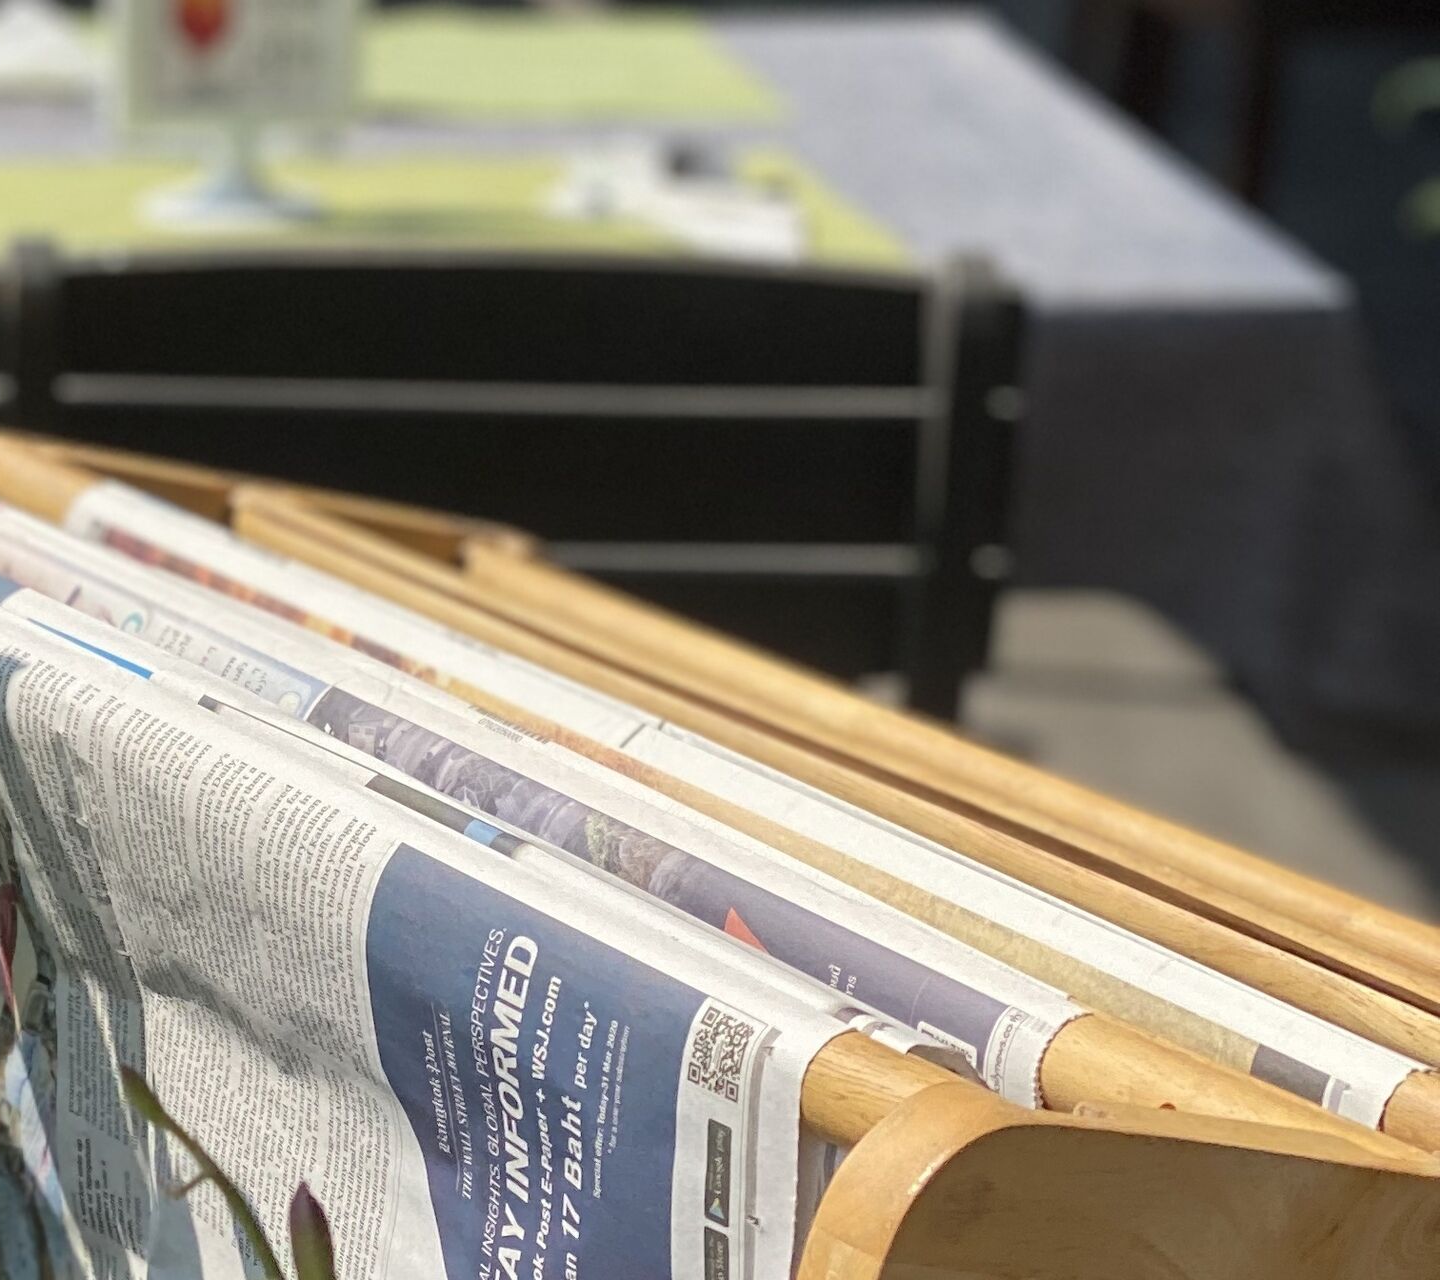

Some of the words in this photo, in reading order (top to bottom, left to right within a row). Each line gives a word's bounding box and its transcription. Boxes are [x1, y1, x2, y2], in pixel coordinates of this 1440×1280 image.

[285, 798, 323, 859] suggestion
[348, 825, 376, 861] below
[470, 927, 508, 1078] PERSPECTIVES.
[531, 976, 562, 1080] WSJ.com
[422, 1029, 442, 1076] Post
[490, 935, 539, 1204] INFORMED
[574, 1052, 589, 1090] per
[479, 1082, 500, 1157] GLOBAL
[535, 1107, 554, 1195] E-Paper
[560, 1094, 583, 1191] Baht
[593, 1158, 602, 1199] Special
[603, 1049, 612, 1072] Mar
[462, 1175, 473, 1199] THE
[481, 1164, 501, 1257] INSIGHTS.
[536, 1199, 552, 1250] Post
[561, 1193, 582, 1240] 17
